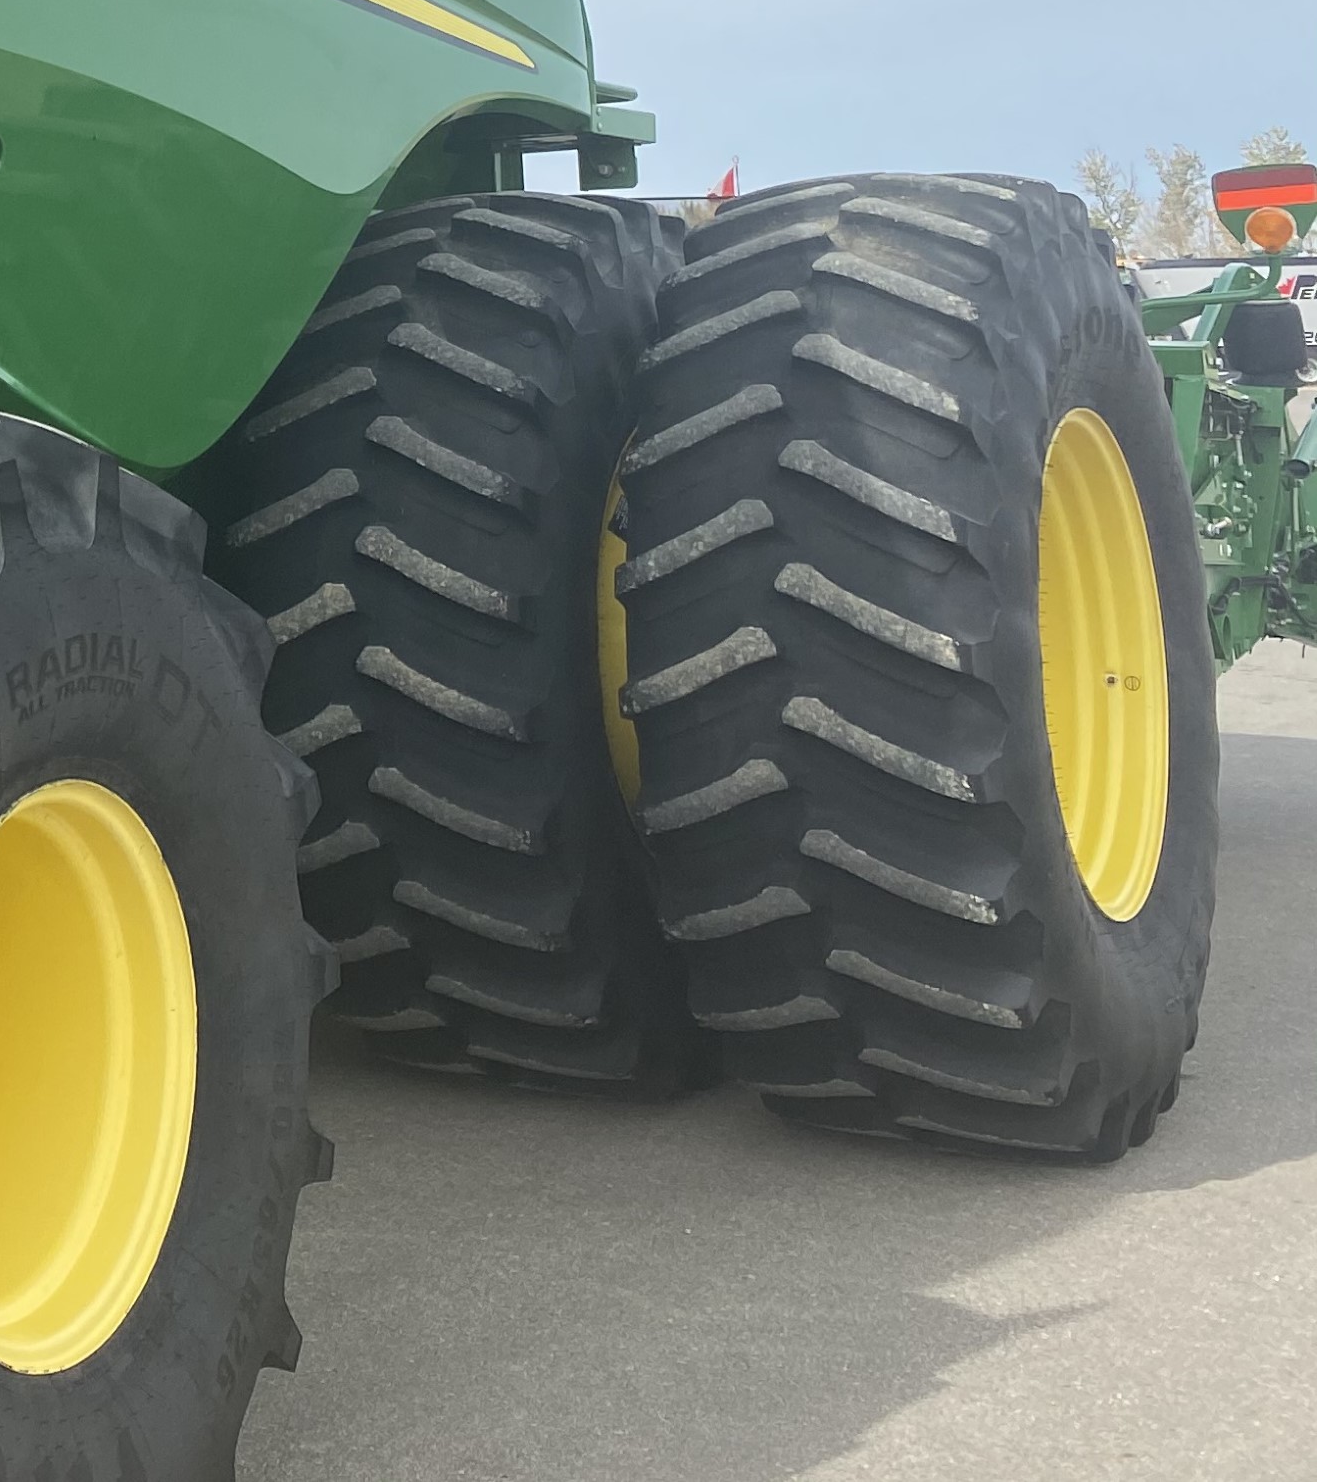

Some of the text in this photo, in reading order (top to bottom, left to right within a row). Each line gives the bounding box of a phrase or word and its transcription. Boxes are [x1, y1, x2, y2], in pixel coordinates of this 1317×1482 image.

[1291, 274, 1317, 300] PE
[6, 632, 223, 756] RADIAL DT
[18, 675, 136, 726] ALL TRACTION
